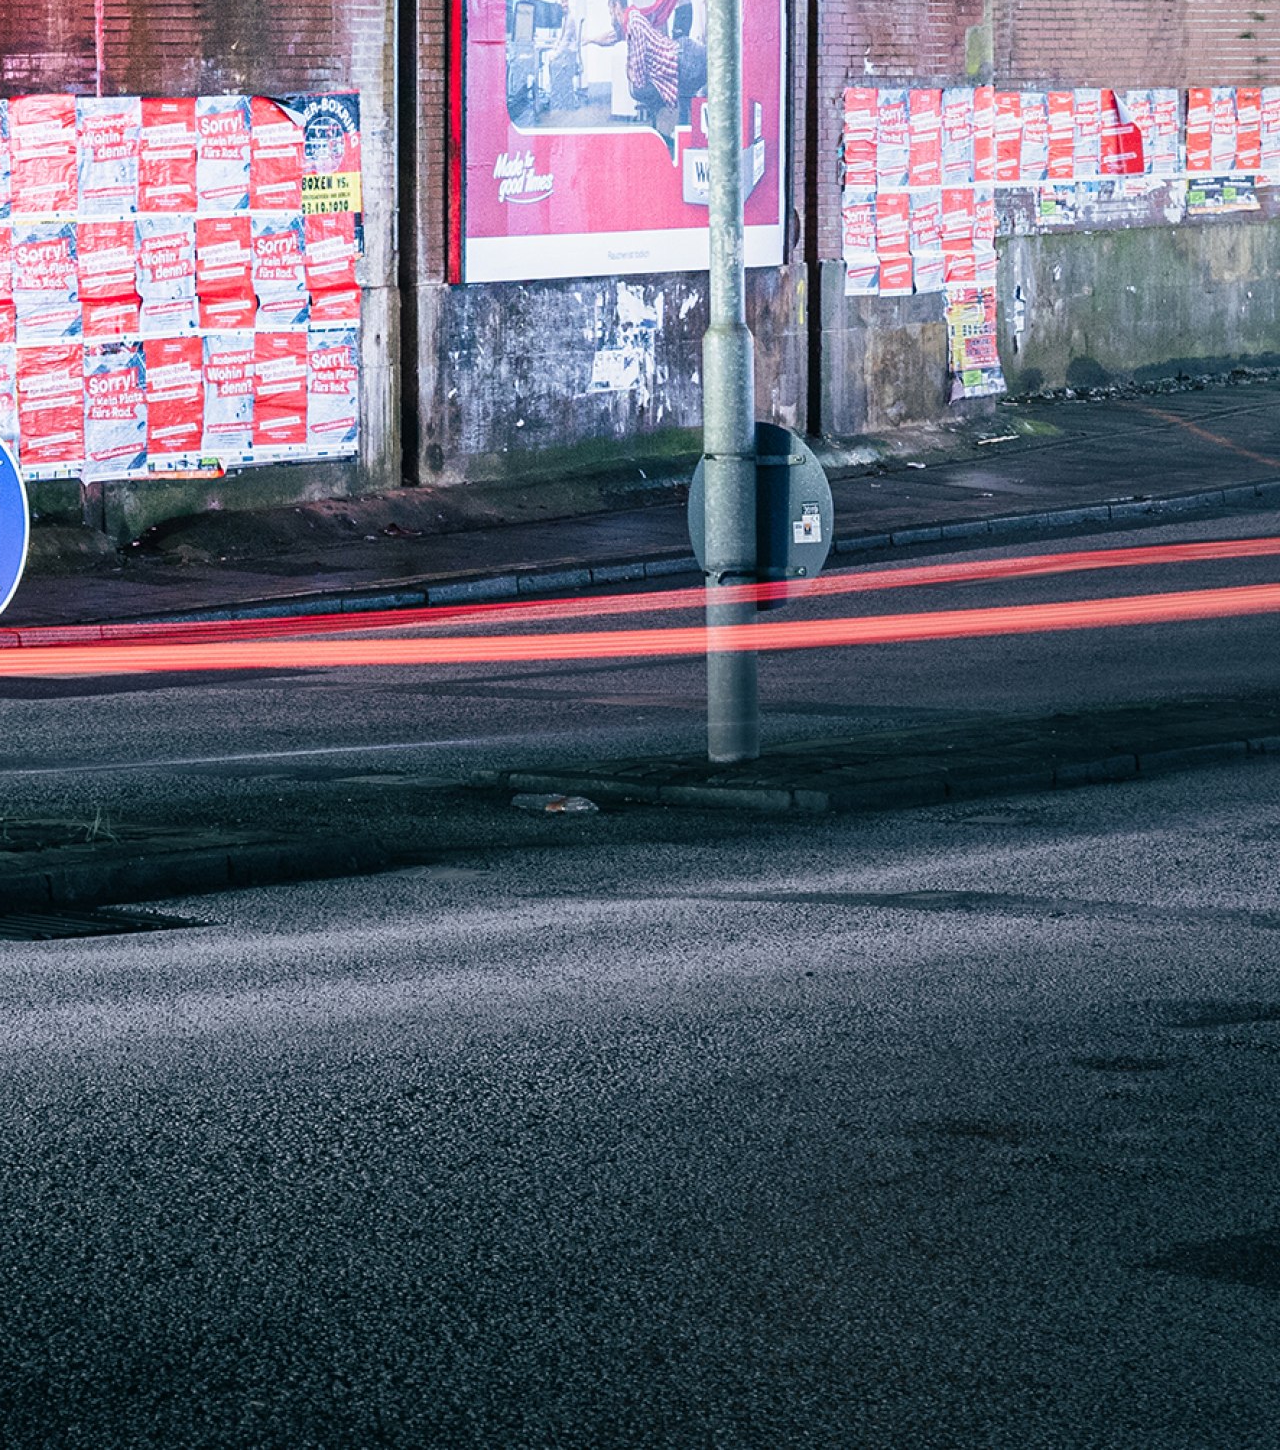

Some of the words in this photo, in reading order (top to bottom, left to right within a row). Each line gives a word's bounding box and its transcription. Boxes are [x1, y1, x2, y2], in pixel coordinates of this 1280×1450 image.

[202, 113, 242, 134] Sorry!
[18, 242, 66, 264] Sorry!
[312, 348, 348, 369] Sorry!
[90, 370, 135, 395] Sorry!
